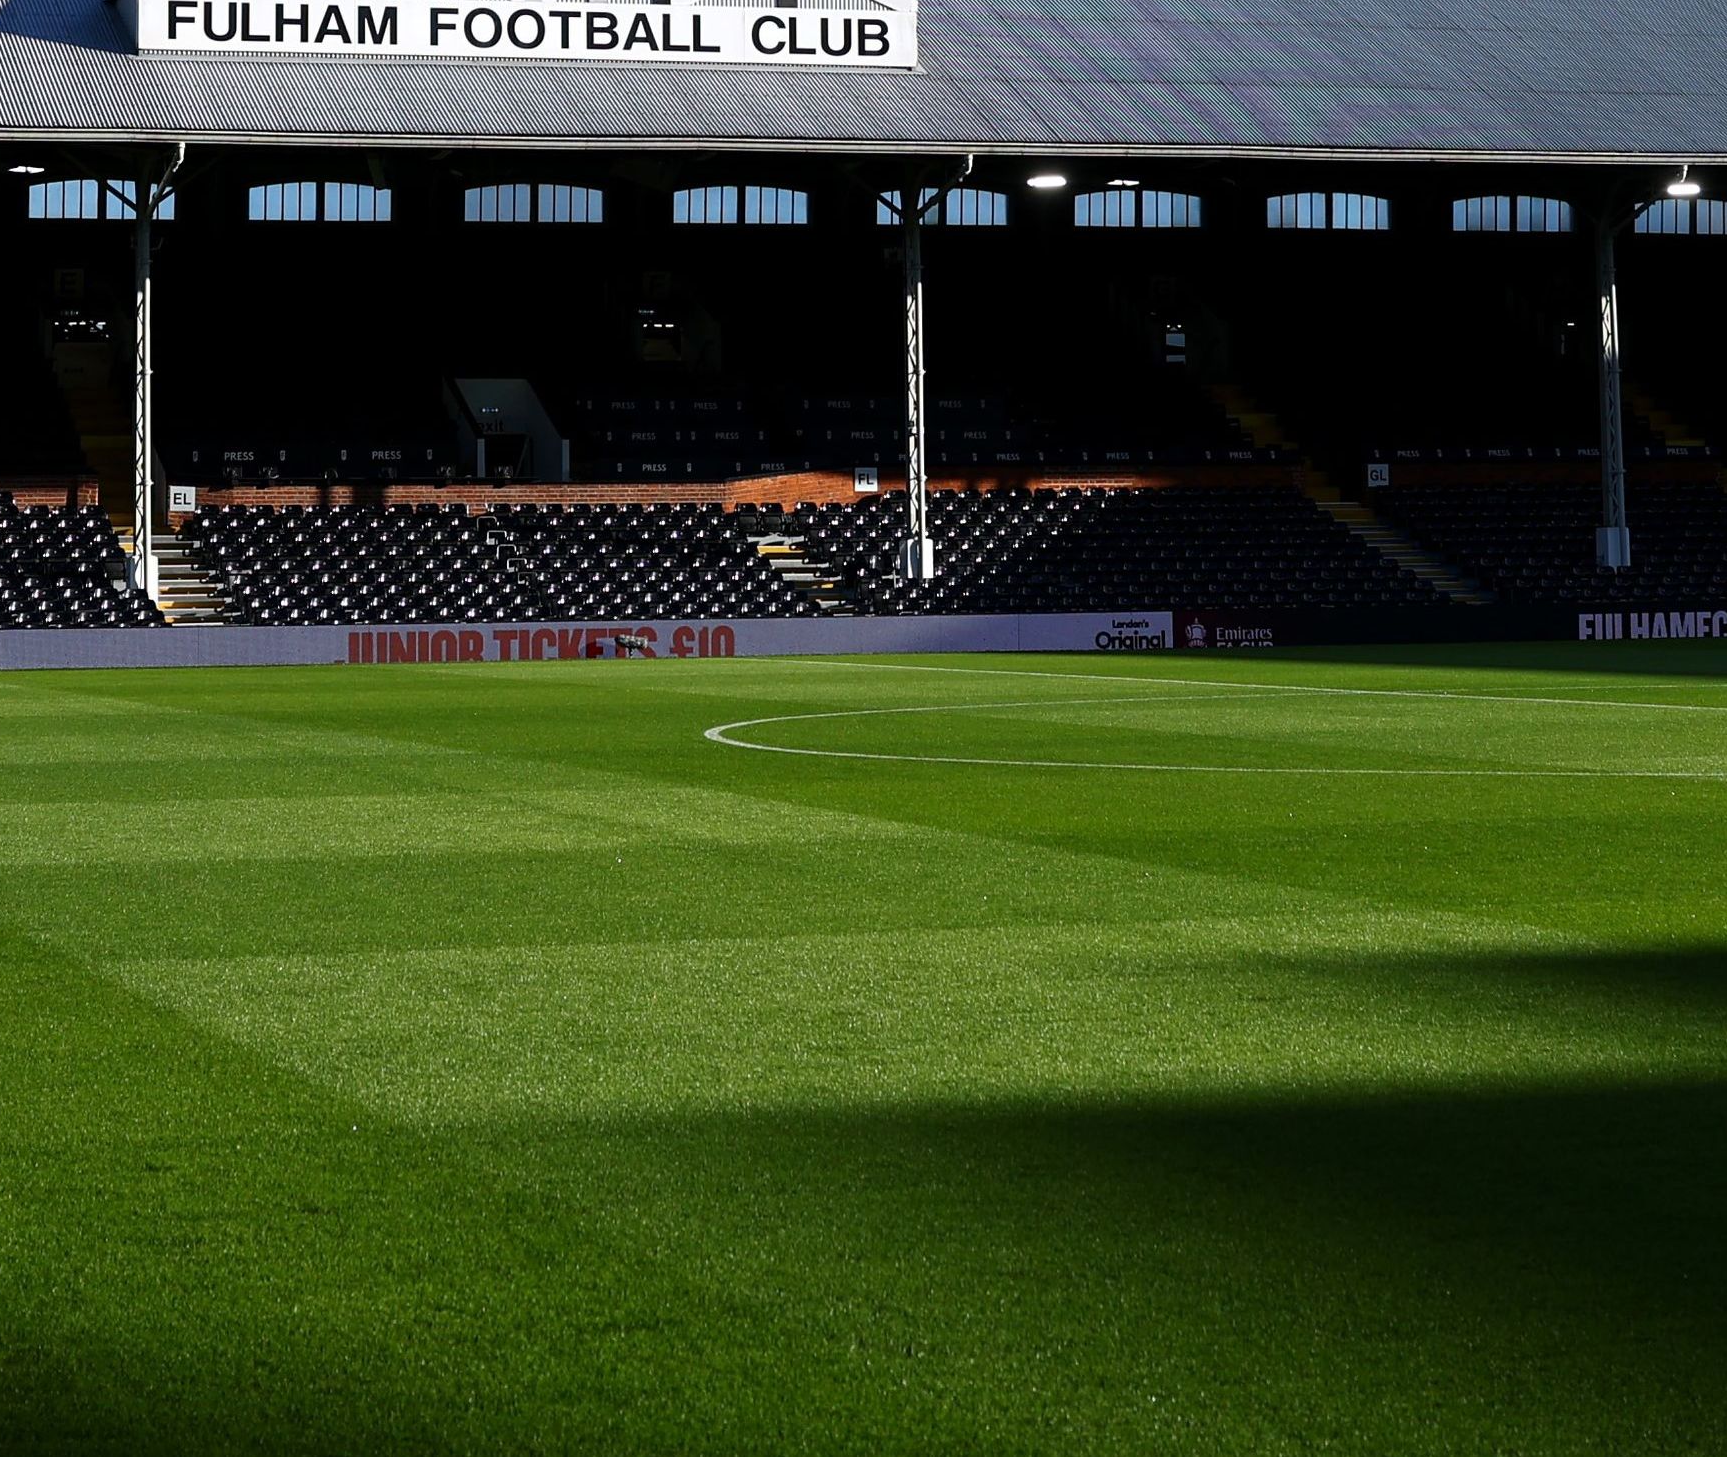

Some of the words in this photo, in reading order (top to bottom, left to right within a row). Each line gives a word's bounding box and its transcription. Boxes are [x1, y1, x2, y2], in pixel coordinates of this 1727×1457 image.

[168, 0, 398, 45] FULHAM
[430, 7, 721, 53] FOOTBALL
[751, 15, 890, 56] CLUB
[224, 450, 255, 461] PRESS
[371, 450, 402, 460] PRESS
[642, 463, 667, 472] PRESS
[760, 463, 785, 472] PRESS
[858, 474, 874, 485] FL
[1370, 469, 1386, 481] GL
[173, 493, 191, 505] EL
[1112, 619, 1149, 628] London's
[1216, 626, 1273, 640] Emirates
[335, 630, 483, 664] JUNIOR
[670, 625, 735, 658] £10
[1095, 630, 1166, 650] Original
